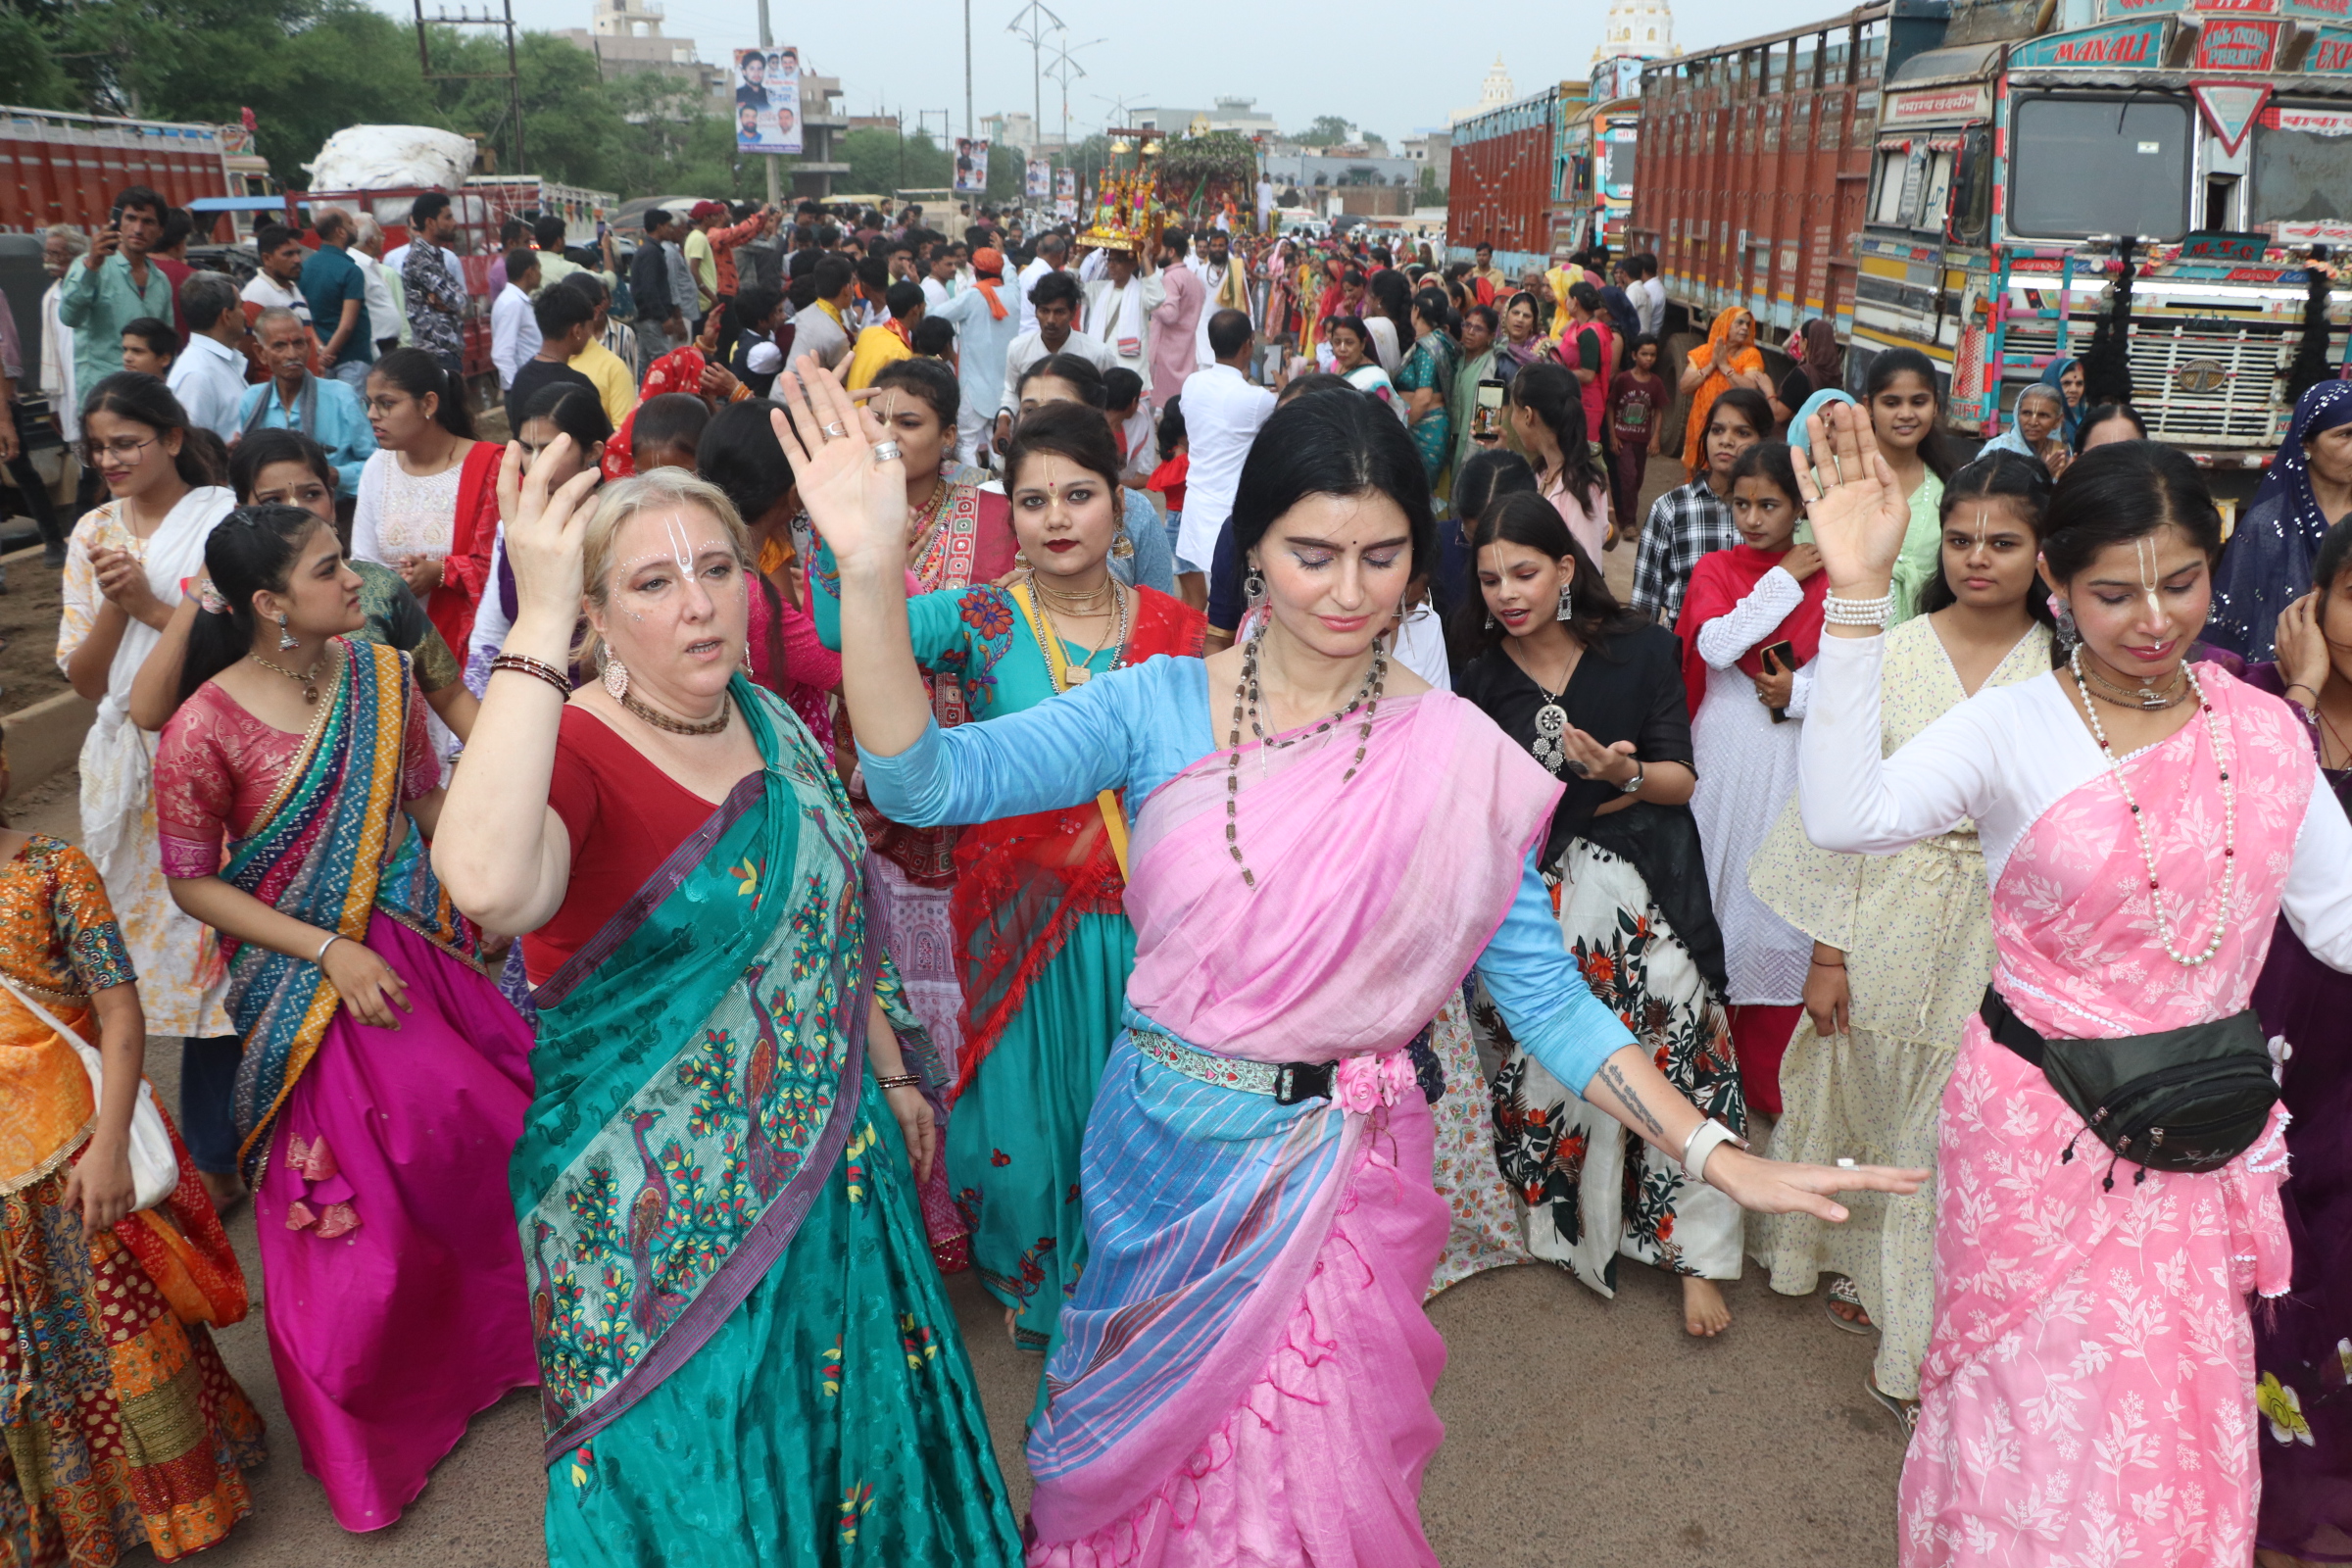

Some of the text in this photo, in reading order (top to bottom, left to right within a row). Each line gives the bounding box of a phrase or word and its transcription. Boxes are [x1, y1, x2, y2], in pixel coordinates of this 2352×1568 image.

[2053, 32, 2150, 62] MANALI
[2208, 49, 2262, 66] PERMIT
[2282, 116, 2342, 129] बाबा
